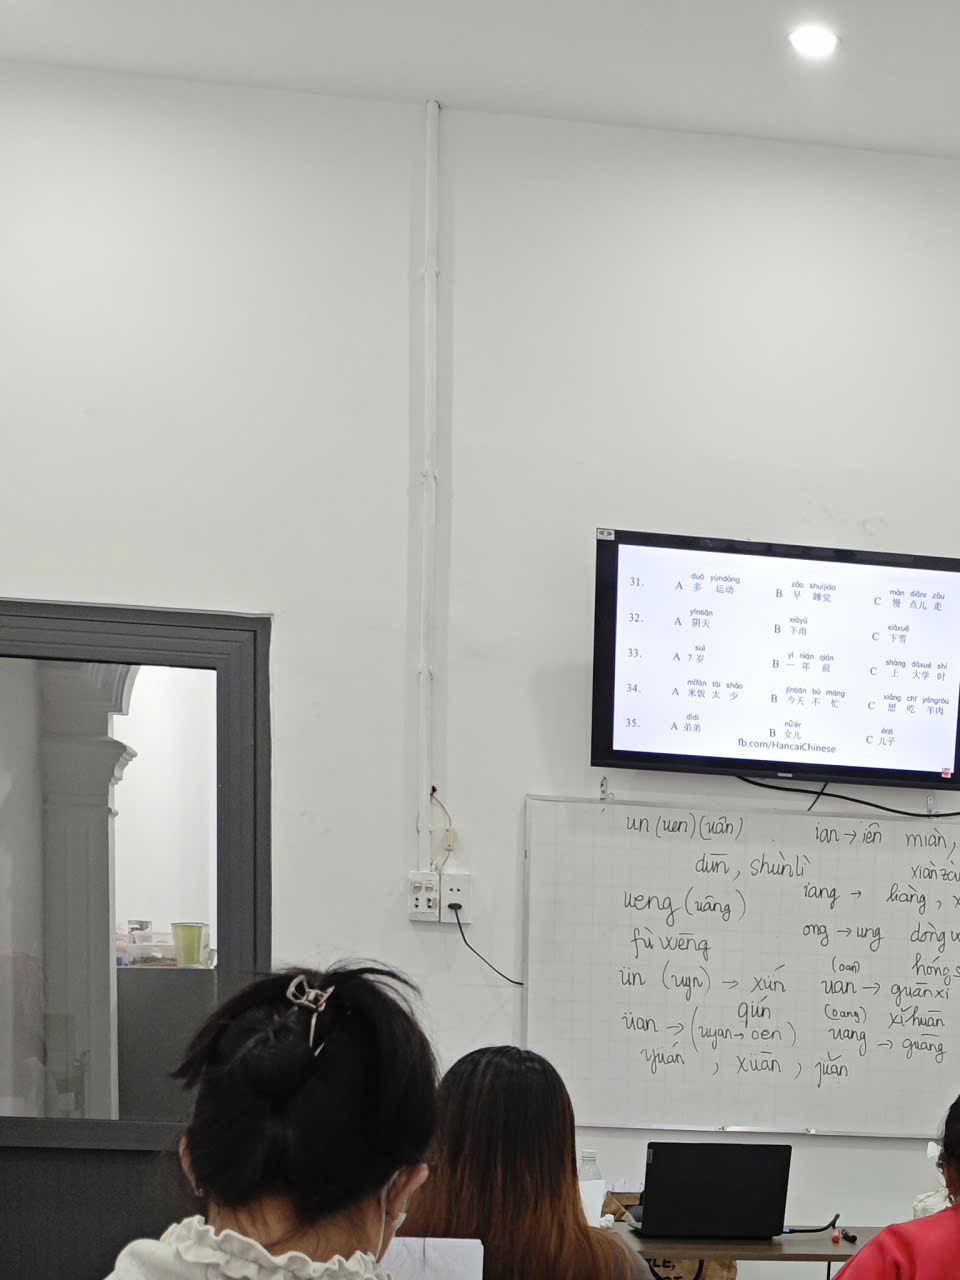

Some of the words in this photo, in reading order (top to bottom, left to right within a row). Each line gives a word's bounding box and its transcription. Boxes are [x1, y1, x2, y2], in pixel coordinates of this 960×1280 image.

[630, 577, 644, 586] 31.
[675, 581, 683, 590] A
[715, 584, 734, 594] 运动
[776, 588, 782, 597] B
[874, 597, 881, 605] C
[629, 613, 644, 622] 32.
[674, 618, 682, 626] A
[774, 624, 781, 633] B
[872, 632, 880, 640] C
[628, 649, 642, 658] 33.
[673, 653, 680, 661] A
[688, 654, 692, 662] 7
[773, 659, 779, 668] B
[870, 667, 877, 675] C
[626, 684, 641, 693] 34.
[672, 688, 679, 696] A
[771, 694, 777, 703] B
[868, 702, 876, 710] C
[626, 718, 640, 728] 35.
[670, 722, 678, 730] A
[770, 728, 776, 737] B
[866, 736, 873, 744] C
[738, 738, 836, 753] fb.com/HancaiChinese
